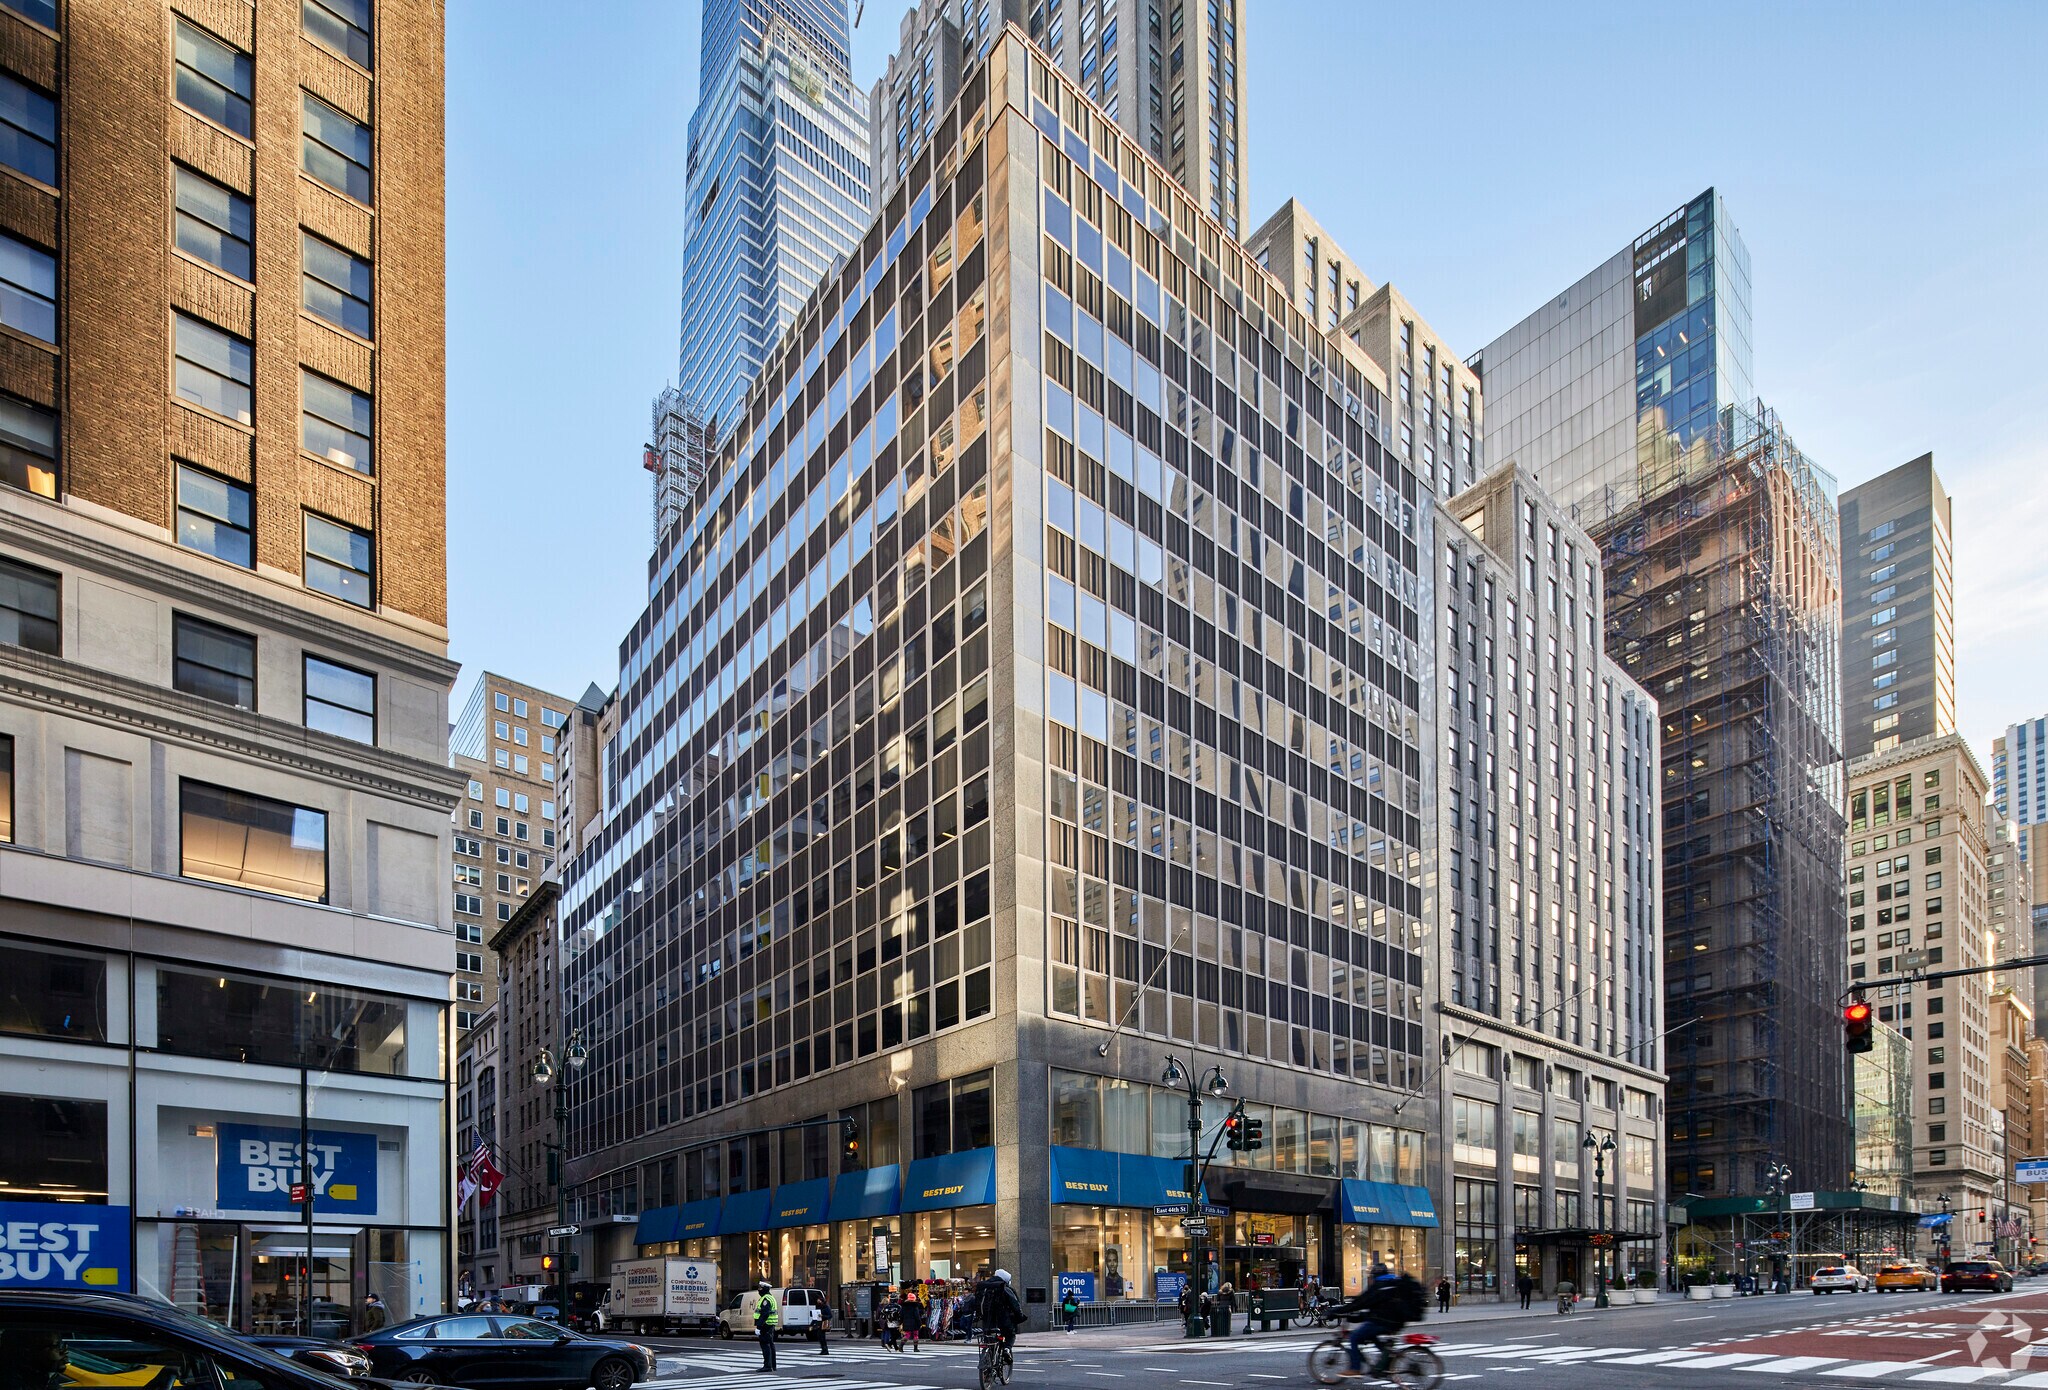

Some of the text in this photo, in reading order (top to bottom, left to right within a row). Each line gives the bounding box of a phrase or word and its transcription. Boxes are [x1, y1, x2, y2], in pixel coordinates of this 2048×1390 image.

[1551, 1053, 1583, 1068] NATIONAL
[1586, 1062, 1612, 1076] BUILDING
[240, 1139, 342, 1170] BEST
[2026, 1169, 2048, 1177] BUS
[248, 1166, 334, 1195] BUY
[923, 1185, 964, 1198] BEST BUY
[1065, 1181, 1109, 1192] BEST BUY
[1166, 1189, 1203, 1199] BEST BY
[781, 1207, 808, 1217] BEST BUY
[1353, 1205, 1368, 1213] BEST
[1410, 1210, 1423, 1218] BEST
[0, 1222, 99, 1251] EST
[628, 1267, 657, 1276] CONFIDENTIAL
[628, 1275, 658, 1285] SHREDDING
[1062, 1276, 1086, 1286] Come
[1073, 1286, 1083, 1294] in.
[1819, 1330, 1957, 1339] BUS
